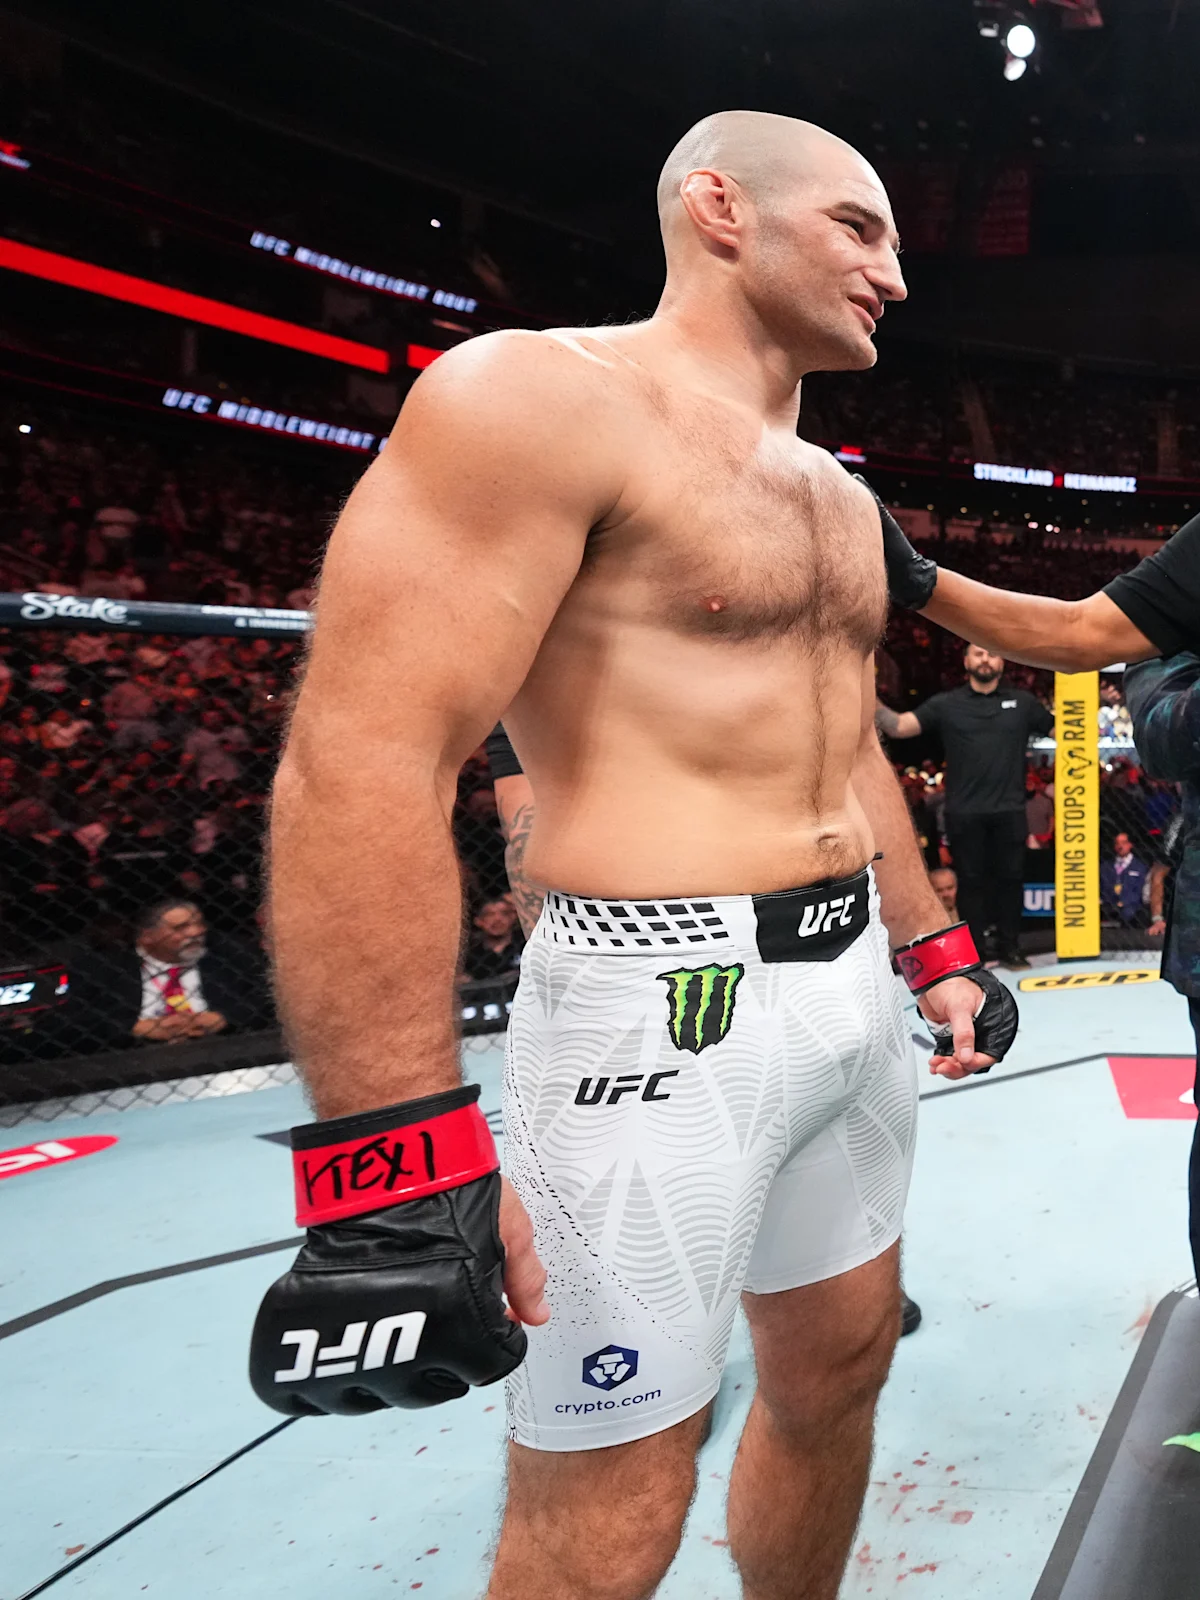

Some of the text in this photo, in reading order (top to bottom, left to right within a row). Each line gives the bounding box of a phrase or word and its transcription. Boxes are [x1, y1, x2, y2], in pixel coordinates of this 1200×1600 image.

[250, 231, 479, 313] UFC MIDDLEWEIGHT BOUT
[162, 387, 213, 414] UFC
[217, 400, 376, 450] MIDDLEWEIGHT
[974, 461, 1053, 487] STRICKLAND
[1064, 472, 1137, 493] HERNANDEZ
[20, 592, 128, 624] Stake
[1063, 699, 1085, 927] NOTHING STOPS RAM
[797, 894, 856, 938] UFC
[1034, 971, 1149, 988] drip
[574, 1069, 680, 1106] UFC
[274, 1311, 426, 1383] UFC
[554, 1389, 662, 1415] crypto.com
